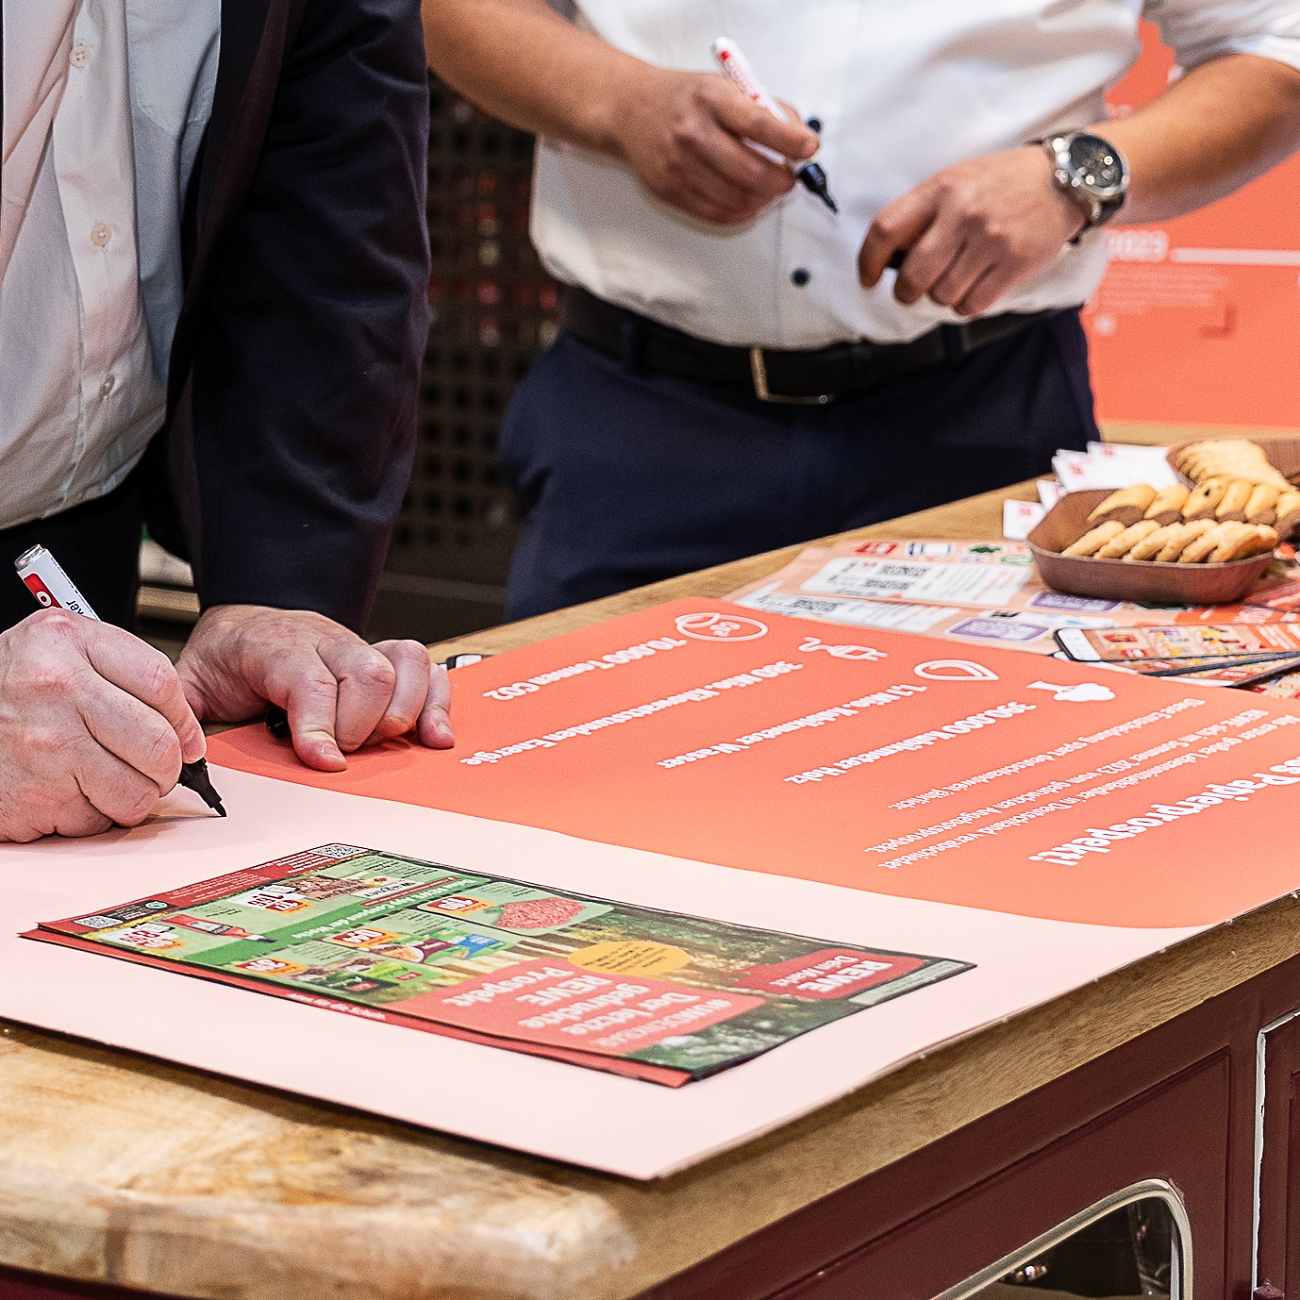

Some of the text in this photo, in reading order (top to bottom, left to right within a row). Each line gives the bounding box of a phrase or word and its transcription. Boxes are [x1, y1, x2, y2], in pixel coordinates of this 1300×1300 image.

[482, 636, 688, 701] 70.000 Tonnen CO2
[542, 687, 720, 741] Kilowattstunden
[735, 706, 859, 745] Kubikmeter
[1077, 711, 1173, 744] Entscheidung
[1220, 708, 1269, 728] REWE
[783, 701, 1037, 784] 390.000 Kubikmeter Holz
[1237, 723, 1278, 741] erster
[459, 738, 557, 765] Energie
[656, 742, 750, 769] Wasser
[1046, 741, 1088, 757] spart
[1129, 740, 1190, 762] Sommer
[943, 754, 1056, 792] deutschlandweit
[1065, 772, 1102, 784] vom
[1076, 752, 1209, 800] Lebensmittelhändler
[1096, 759, 1141, 775] 2023
[992, 780, 1072, 809] gedruckten
[863, 806, 1002, 853] Angebotsprospekt.
[976, 802, 1073, 835] Deutschland
[877, 833, 984, 870] verabschiedet
[441, 966, 575, 1007] Prospekt
[768, 955, 859, 987] Dein Markt
[796, 960, 893, 993] REWE
[515, 974, 613, 1007] REWE
[518, 982, 650, 1029] gedruckte
[560, 992, 701, 1035] Der letzte
